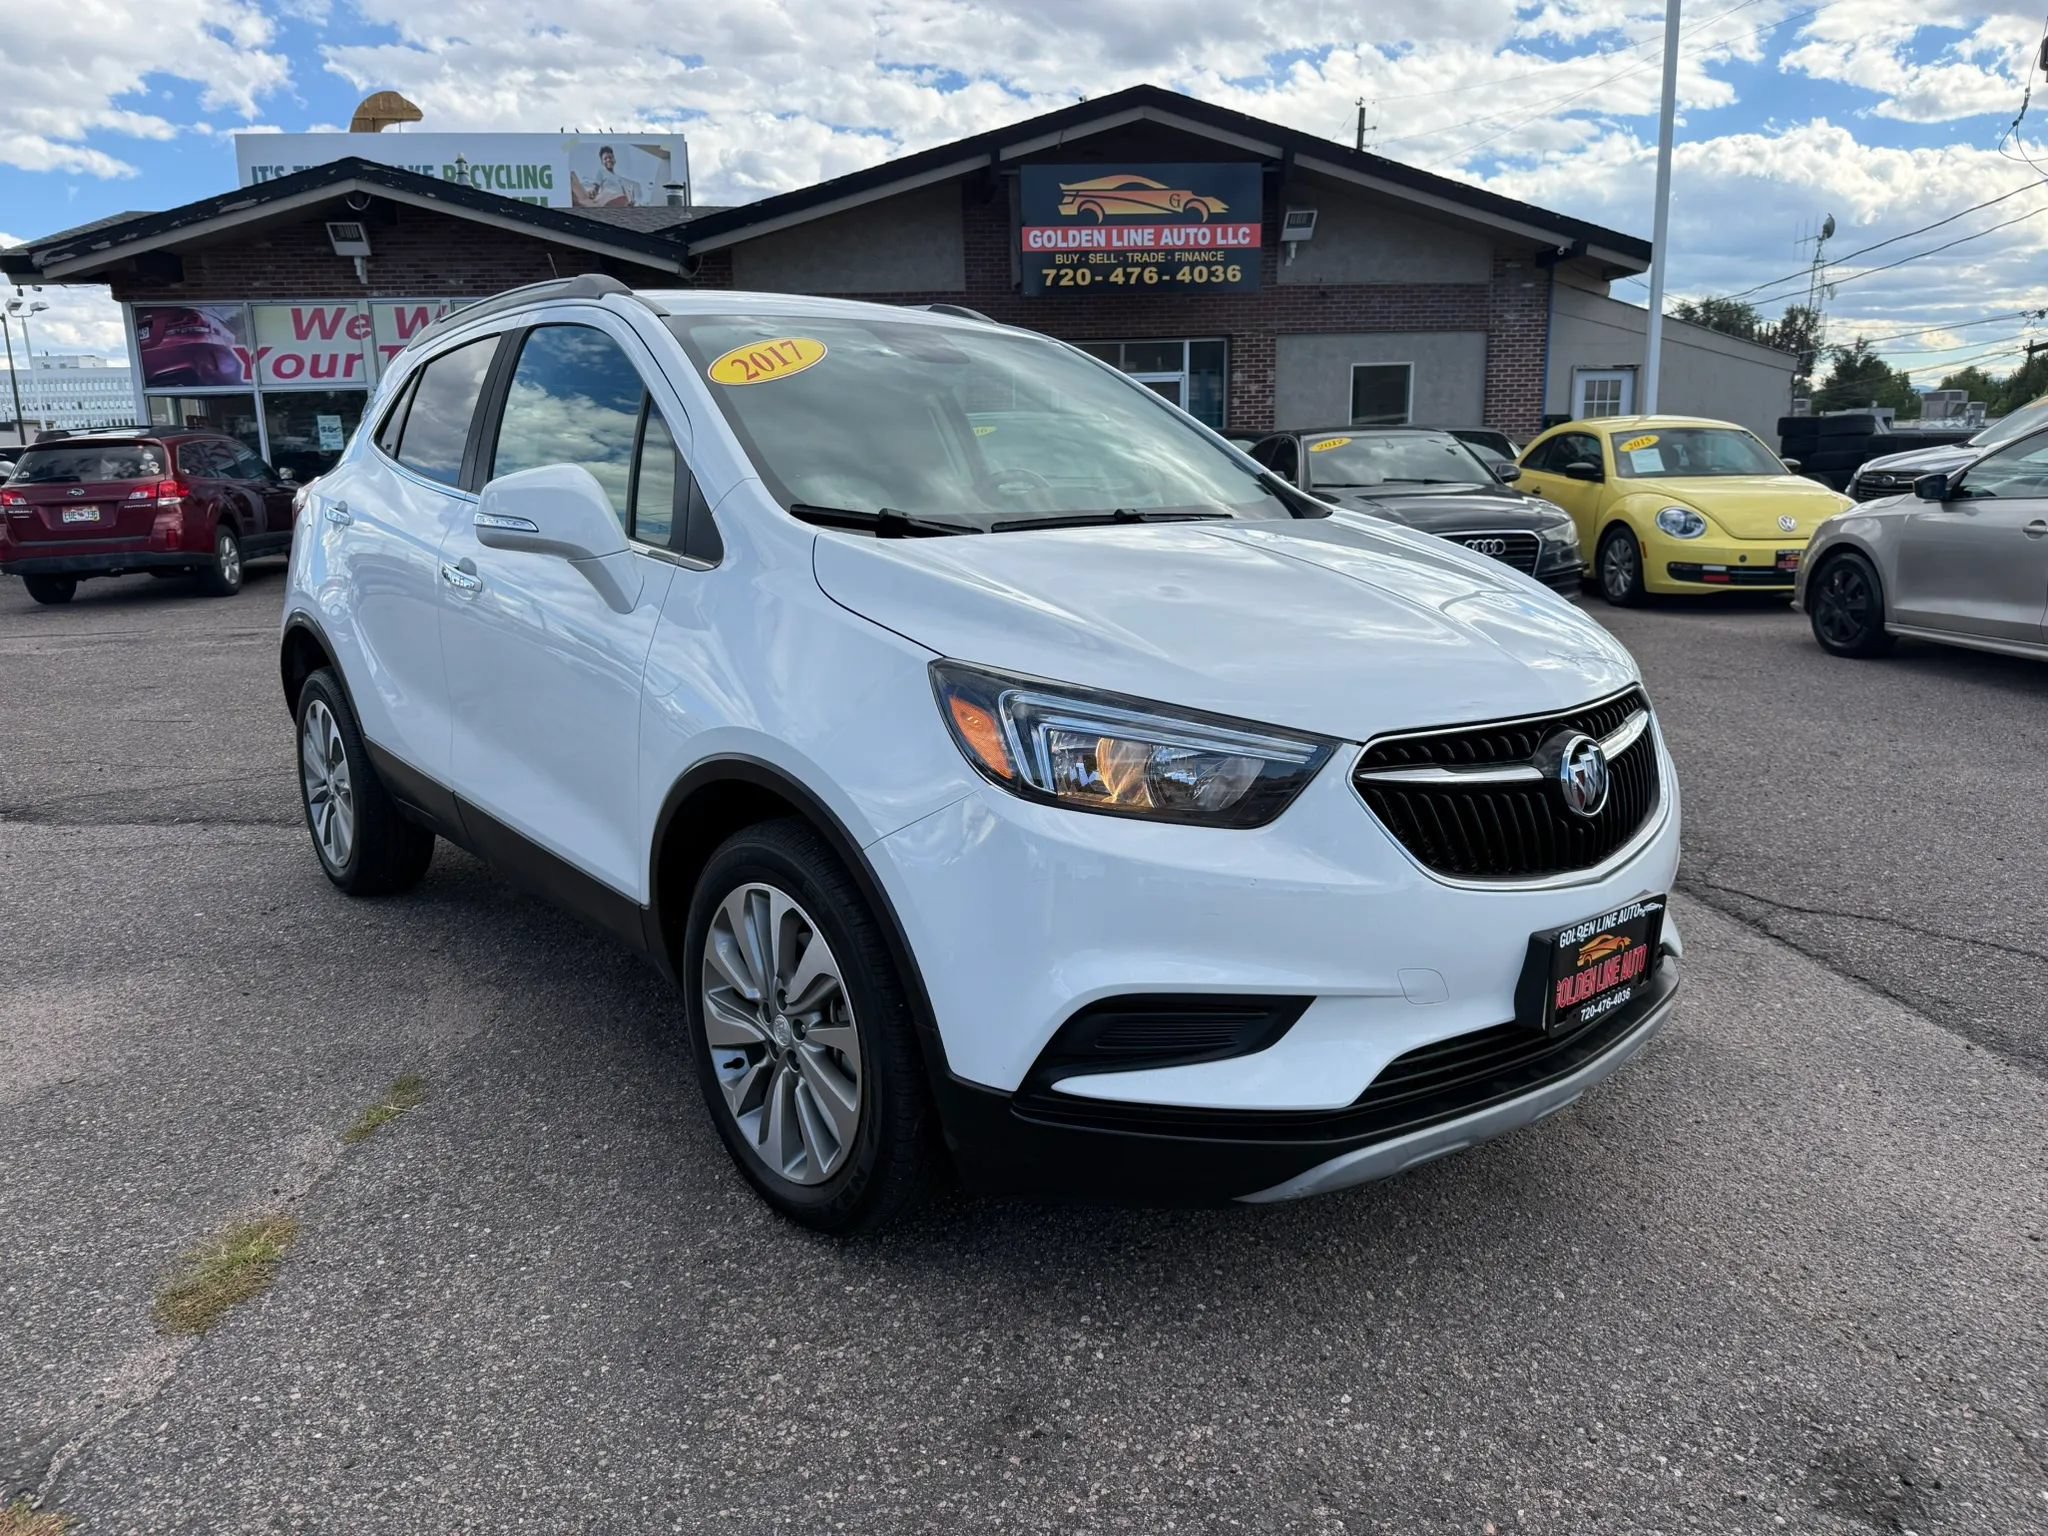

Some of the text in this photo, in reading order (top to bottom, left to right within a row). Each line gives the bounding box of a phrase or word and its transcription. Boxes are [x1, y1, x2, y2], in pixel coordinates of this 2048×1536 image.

[443, 164, 554, 190] RCYCLING
[1028, 226, 1250, 248] GOLDEN LINE AUTO LLC
[1055, 250, 1225, 265] BUY SELL TRADE FINANCE
[290, 306, 372, 341] We
[232, 346, 364, 380] Your
[731, 340, 803, 381] 2017
[1560, 902, 1641, 948] GOLDEN LINE AUTO
[1597, 954, 1621, 993] LINE
[1620, 943, 1648, 982] AUTO
[1580, 987, 1631, 1022] 720-476-4036
